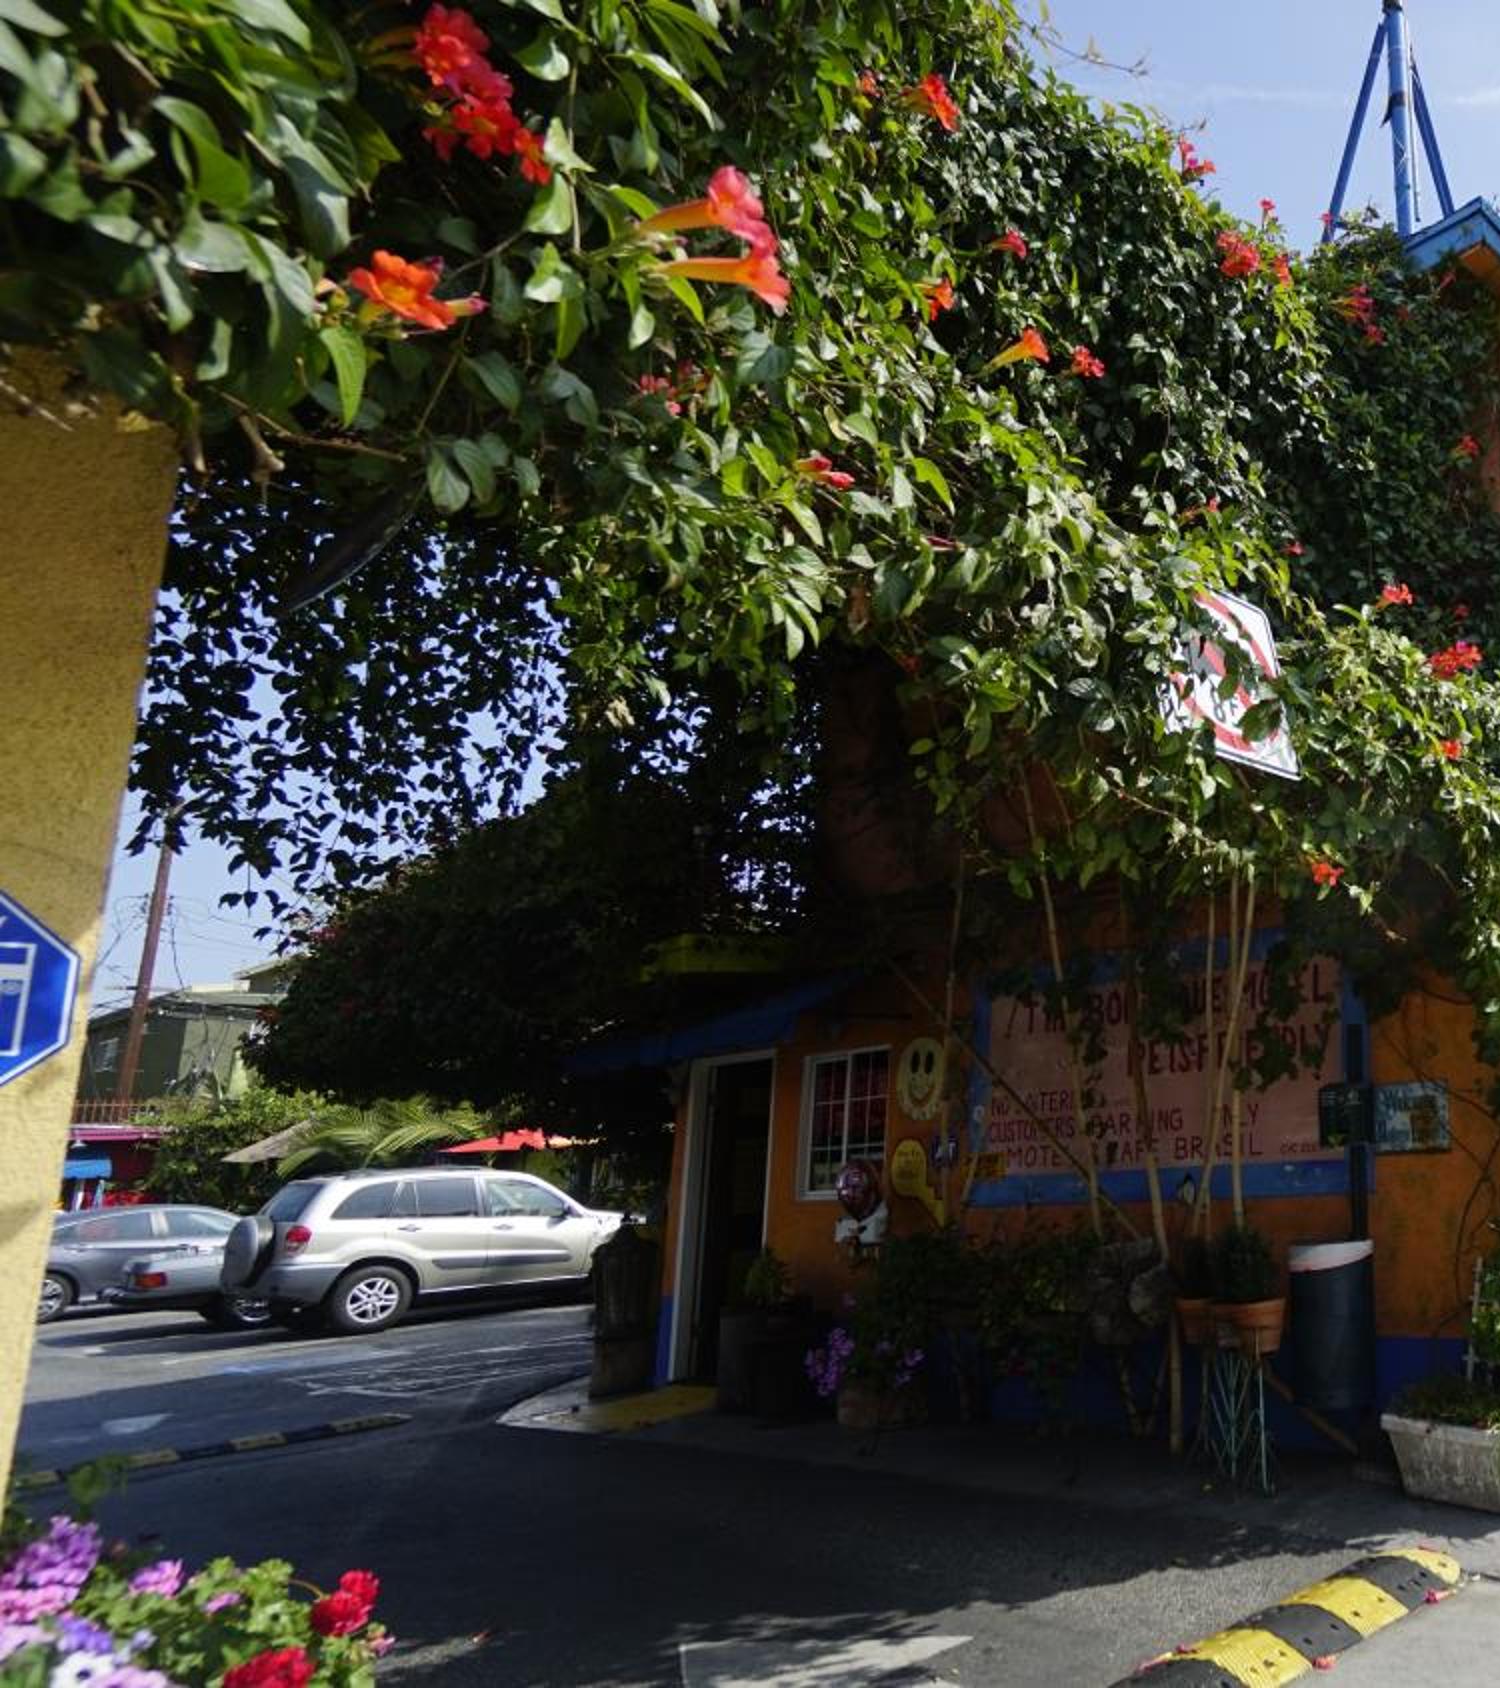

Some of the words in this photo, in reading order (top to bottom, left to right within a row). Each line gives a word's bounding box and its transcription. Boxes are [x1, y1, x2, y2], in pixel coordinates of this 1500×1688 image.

[1088, 1107, 1183, 1137] PARING
[1006, 1144, 1070, 1168] MOTE
[1174, 1132, 1264, 1160] BRSIL
